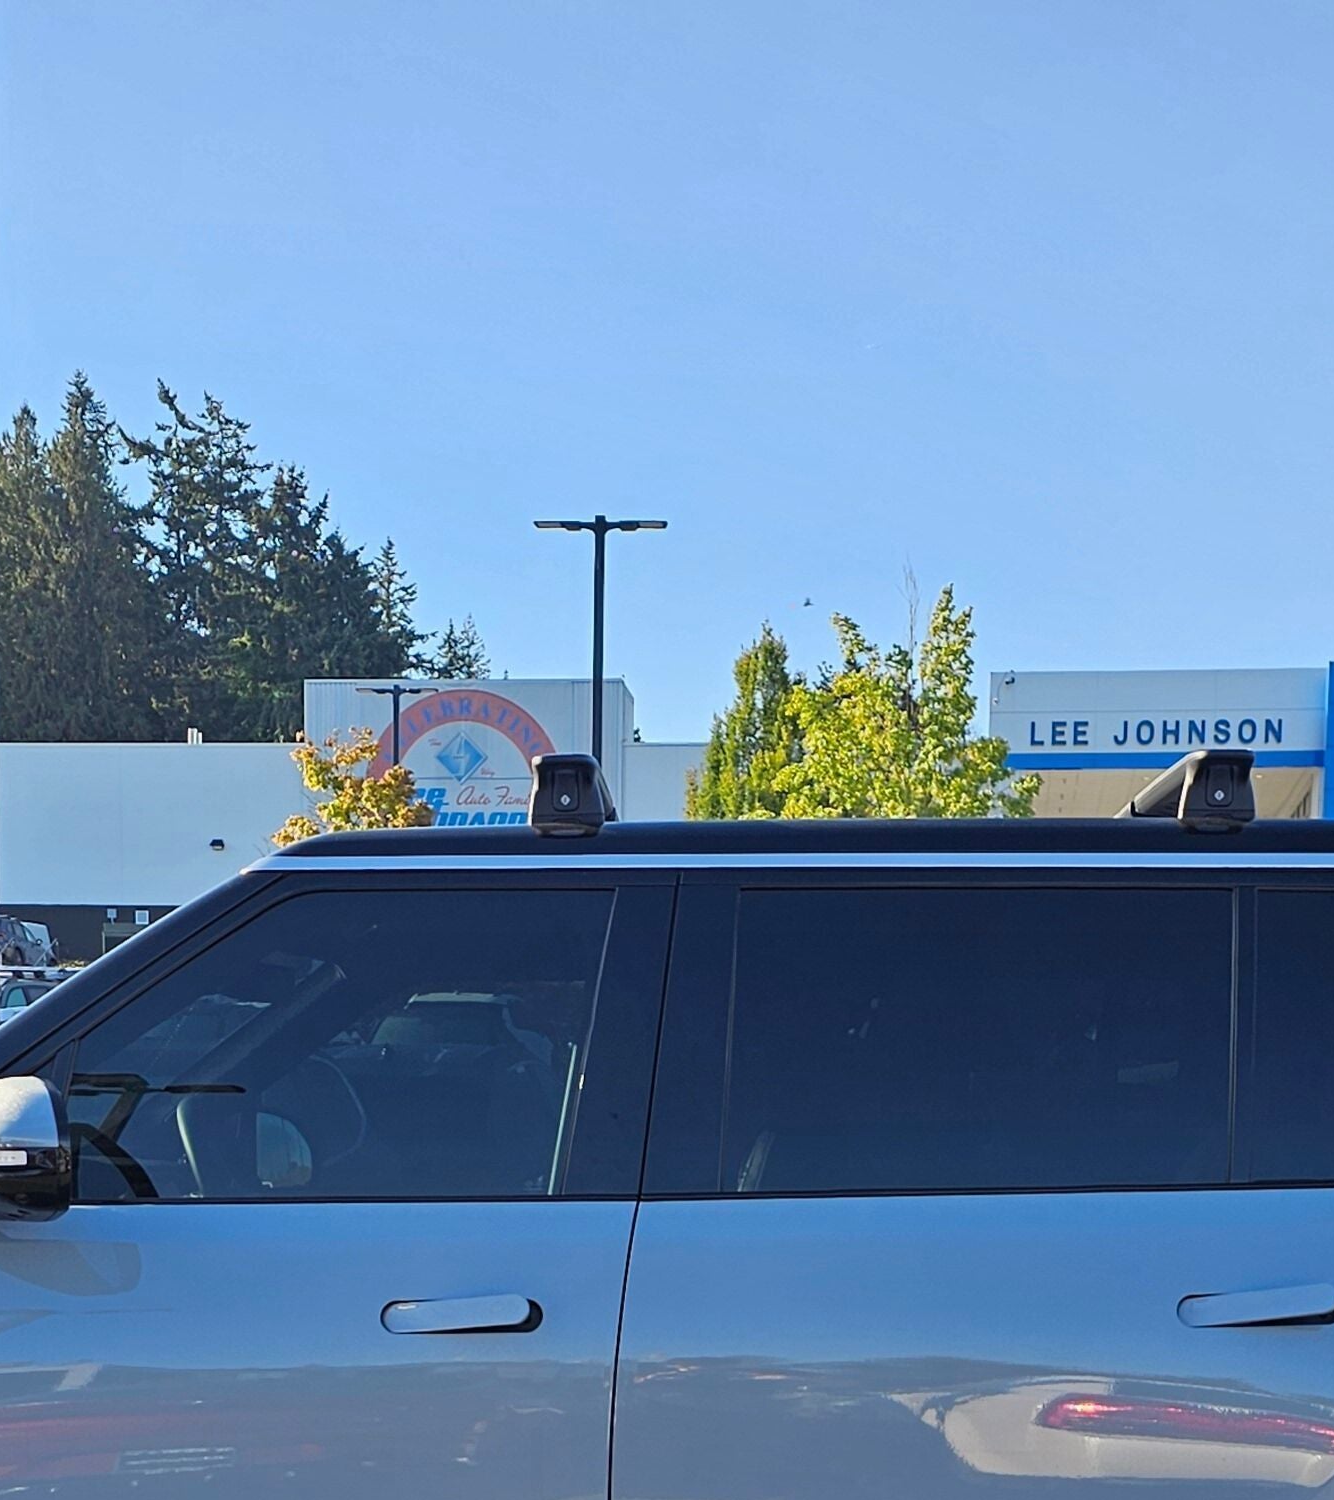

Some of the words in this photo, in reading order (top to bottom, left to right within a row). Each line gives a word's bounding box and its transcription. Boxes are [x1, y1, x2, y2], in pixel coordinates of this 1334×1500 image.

[1029, 720, 1089, 747] LEE
[1113, 718, 1283, 746] JOHNSON
[456, 785, 491, 806] Auto
